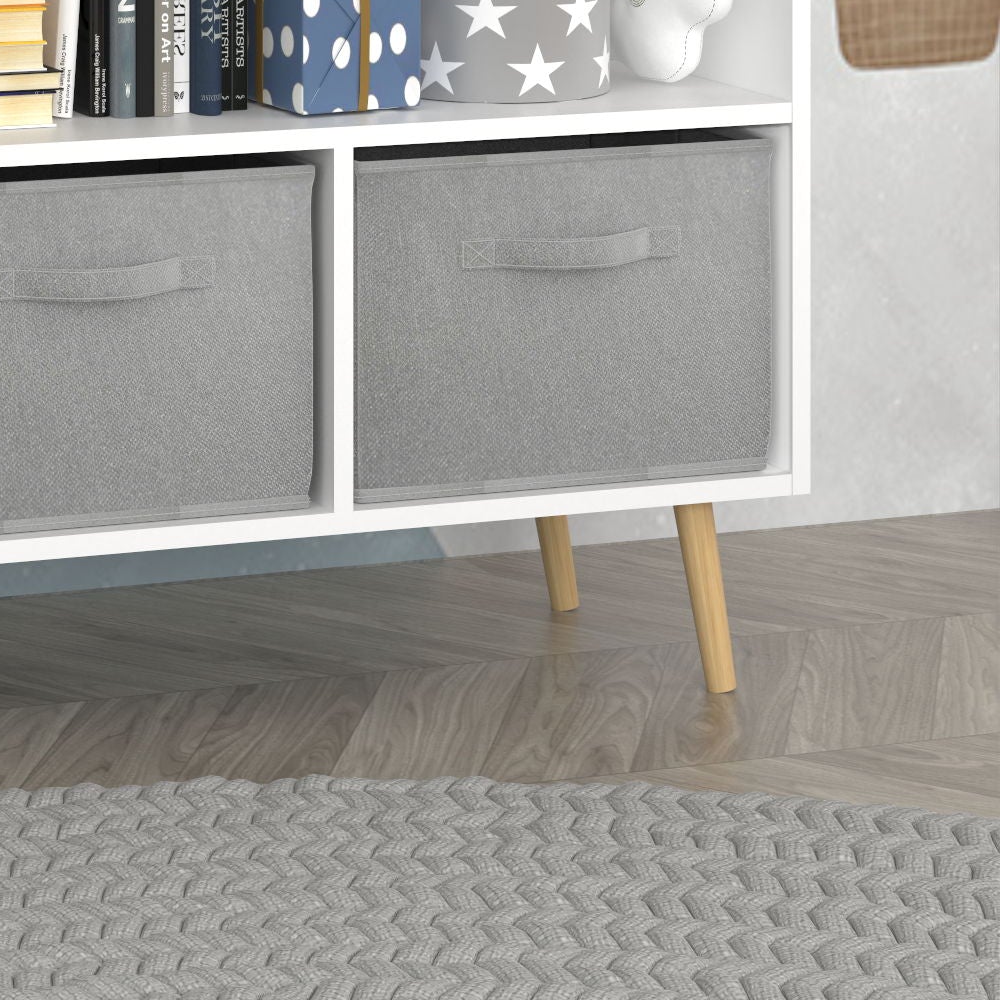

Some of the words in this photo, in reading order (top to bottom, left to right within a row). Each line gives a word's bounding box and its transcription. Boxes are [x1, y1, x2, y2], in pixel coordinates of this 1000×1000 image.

[161, 12, 169, 32] on
[161, 37, 171, 63] Art
[160, 72, 170, 113] ivorypress
